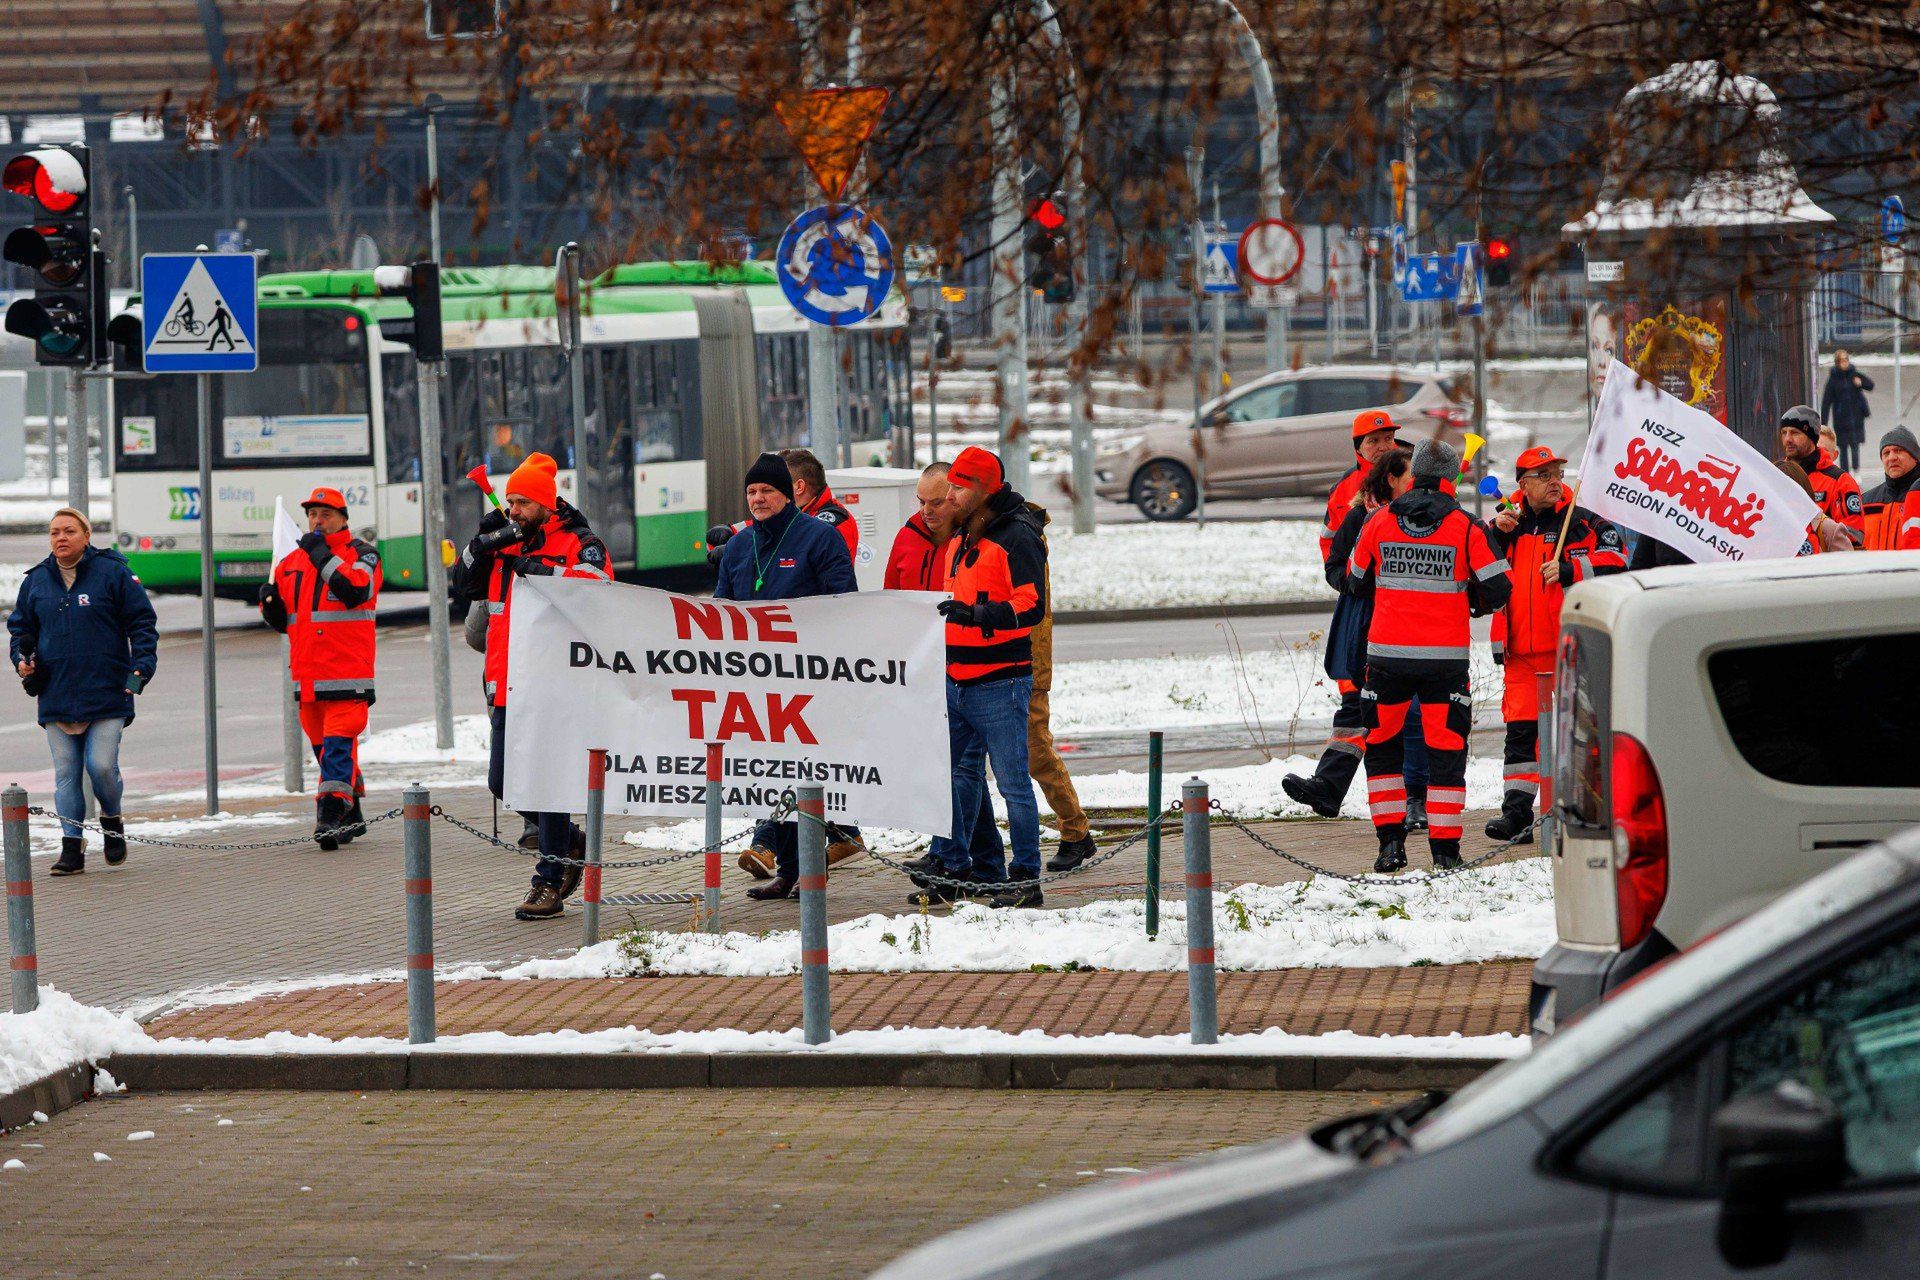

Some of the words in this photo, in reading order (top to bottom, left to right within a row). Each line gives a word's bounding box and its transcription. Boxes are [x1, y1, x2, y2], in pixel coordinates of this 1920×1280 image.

[1641, 418, 1685, 447] NSZZ
[340, 485, 369, 506] 62
[1605, 482, 1665, 514] REGION
[1665, 506, 1745, 562] PODLASKI
[1381, 560, 1453, 577] MEDYCZNY
[1383, 546, 1452, 563] RATOWNIK
[669, 596, 798, 644] NIE
[645, 649, 907, 687] KONSOLIDACJI
[671, 688, 819, 745] TAK
[656, 756, 883, 786] BEZIECZEŃSTWA
[626, 783, 797, 808] MIESZAŃCÓ
